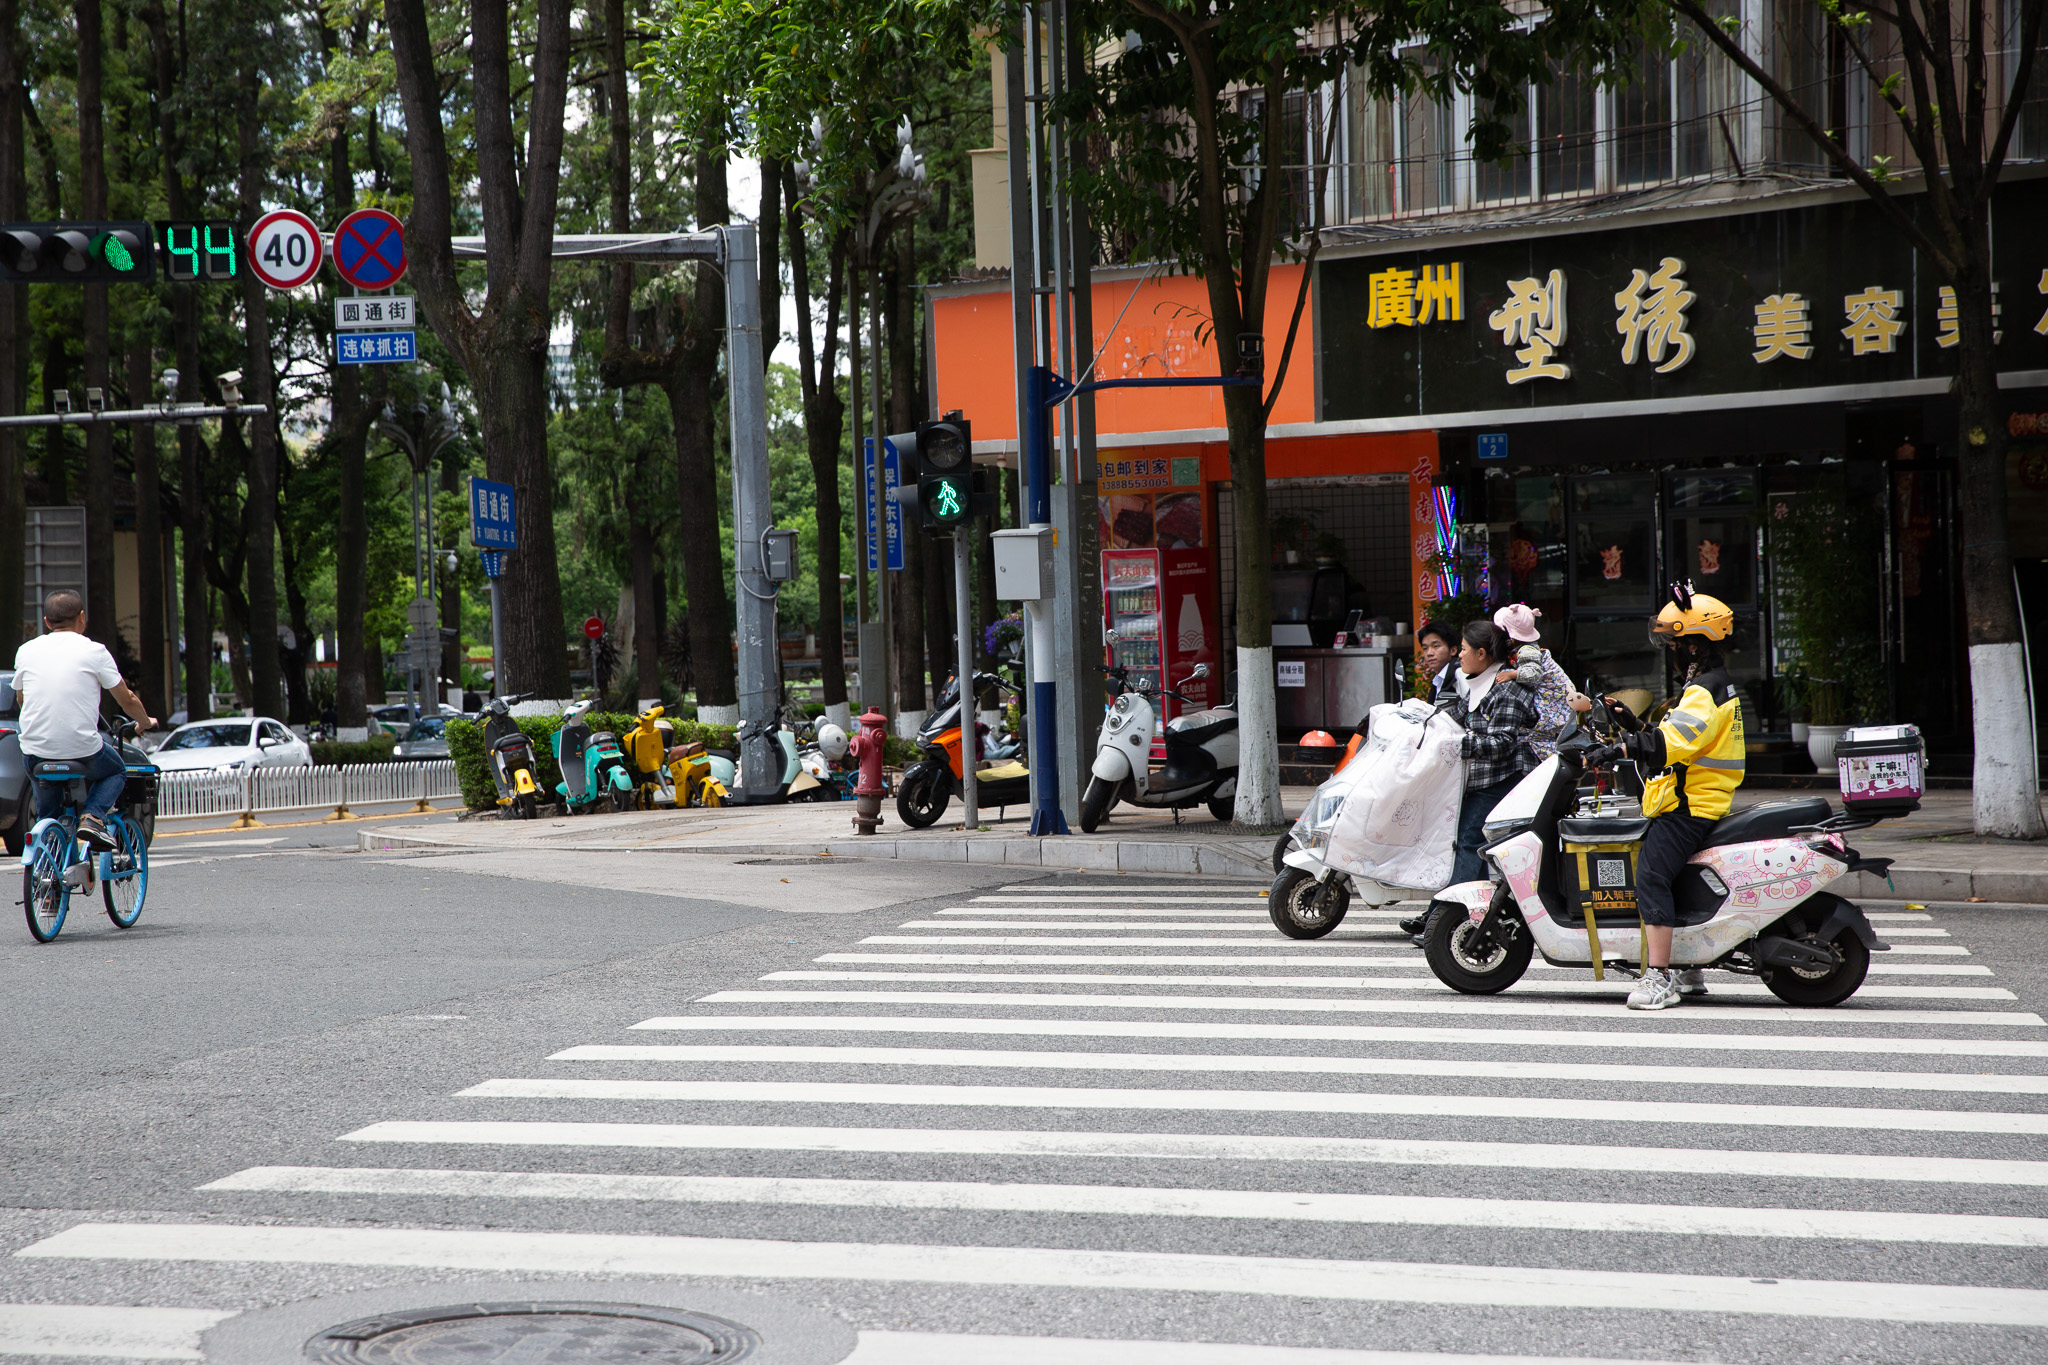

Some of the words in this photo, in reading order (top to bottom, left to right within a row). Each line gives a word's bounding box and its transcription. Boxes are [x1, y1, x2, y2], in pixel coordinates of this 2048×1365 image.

[167, 225, 235, 276] 44
[263, 233, 307, 267] 40
[1366, 261, 1464, 328] 廣州
[343, 301, 407, 321] 圆通街
[343, 337, 409, 358] 违停抓拍
[1490, 444, 1496, 455] 2
[1101, 478, 1169, 490] 13888553005
[478, 488, 510, 523] 圆通街
[1113, 564, 1151, 577] 农夫山泉
[1181, 682, 1207, 694] 农夫山泉
[1591, 890, 1635, 901] 加入骑手
